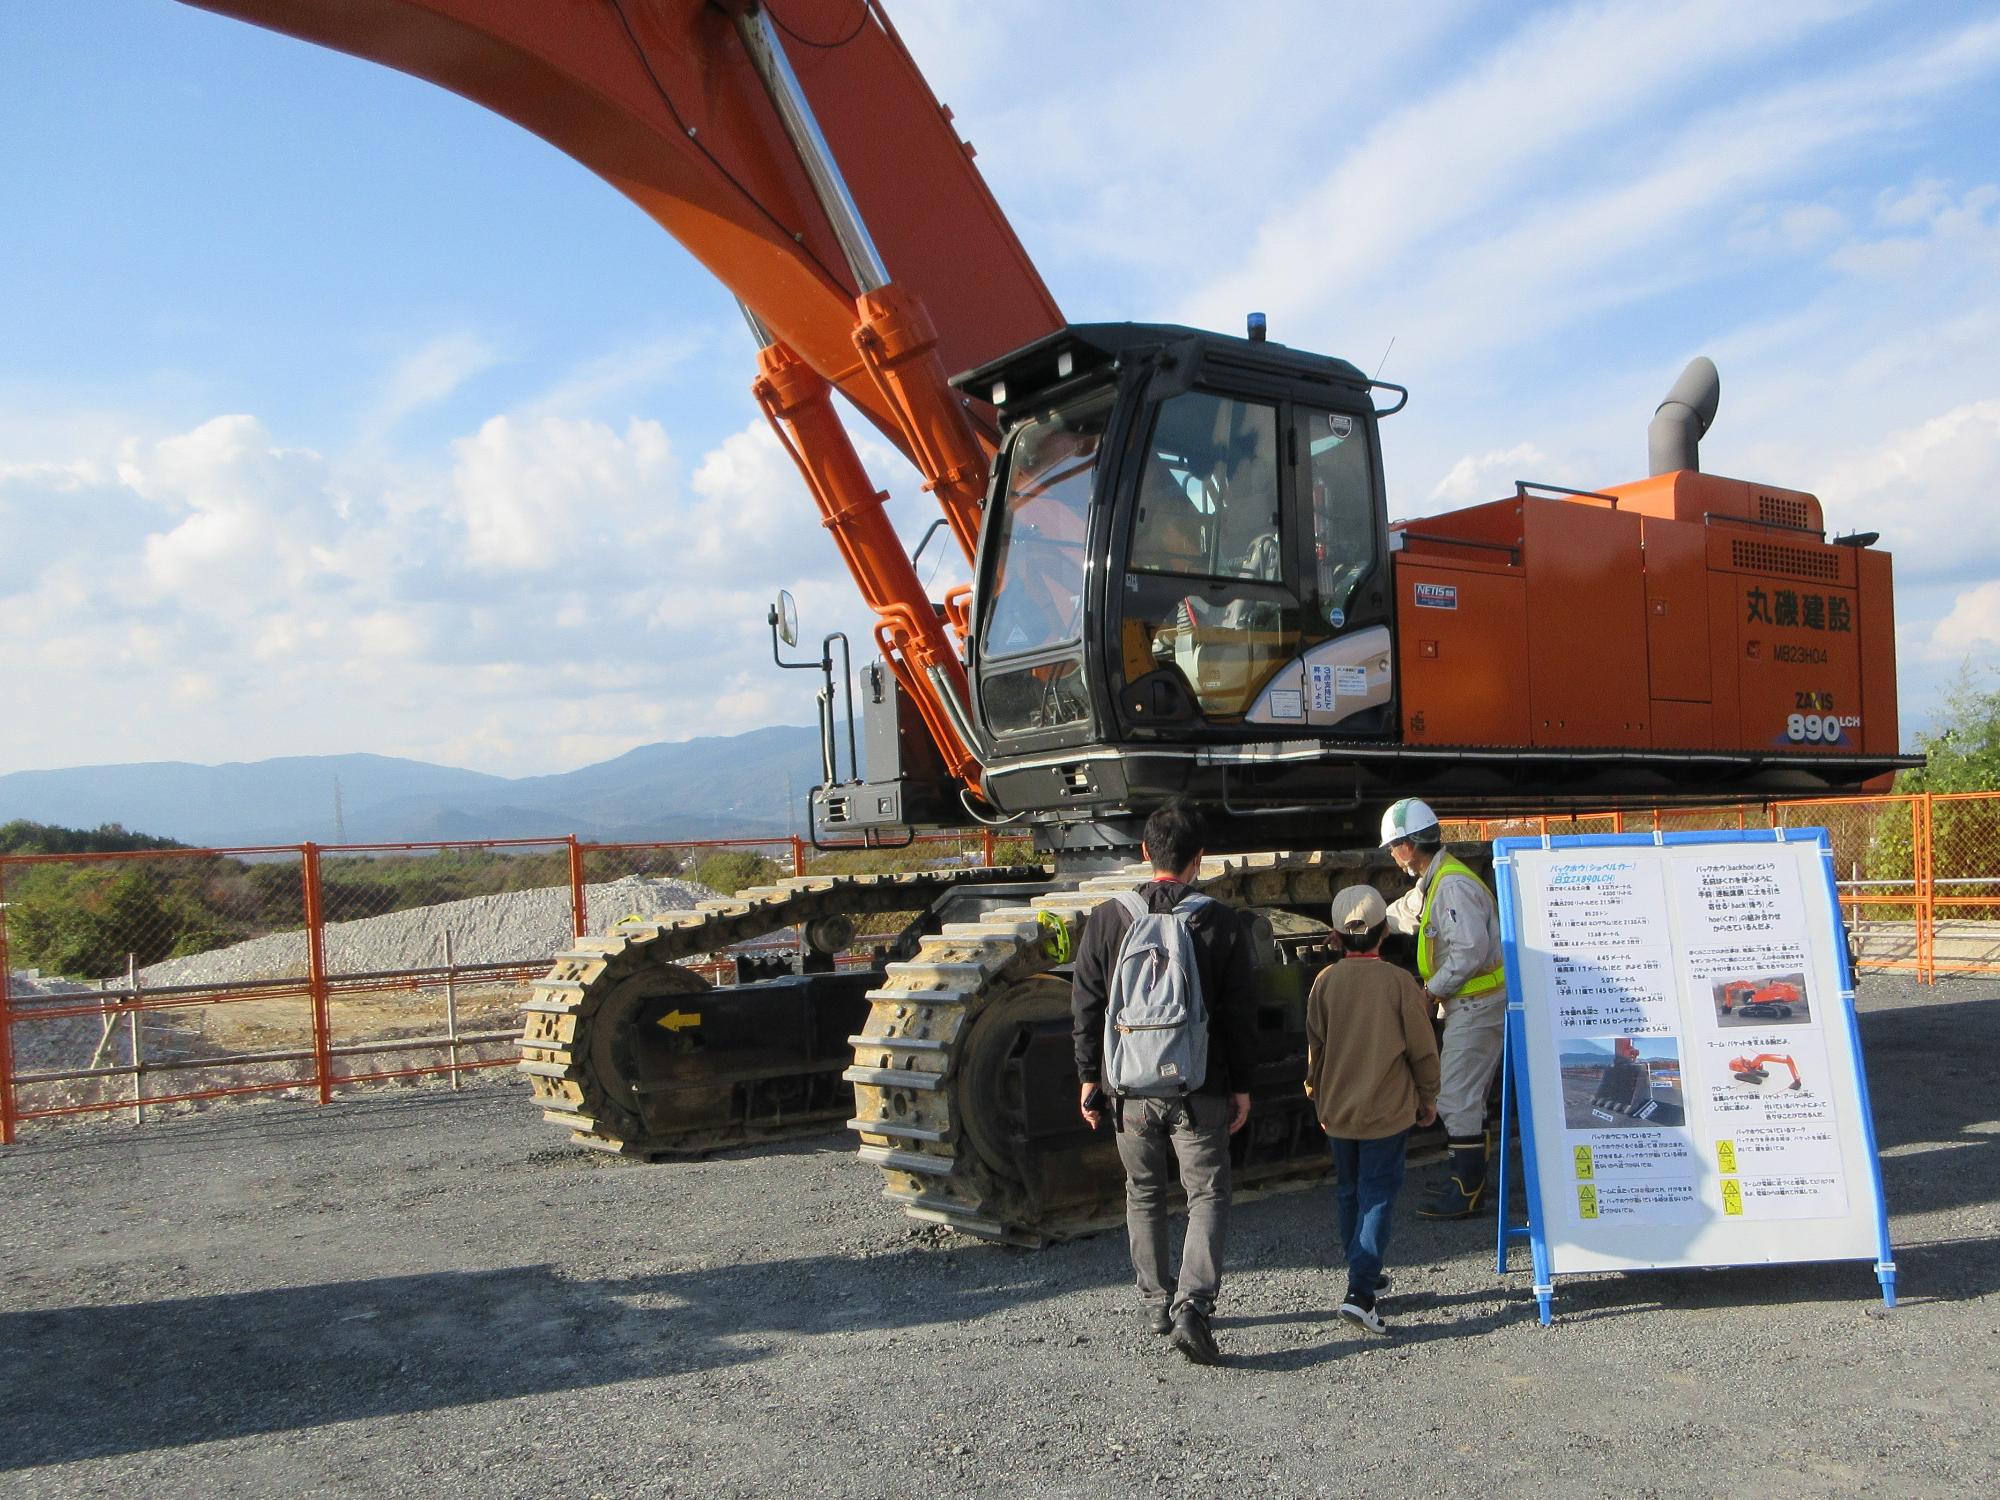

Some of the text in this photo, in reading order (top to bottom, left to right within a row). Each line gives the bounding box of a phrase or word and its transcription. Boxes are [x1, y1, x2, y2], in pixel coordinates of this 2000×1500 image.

[1417, 585, 1445, 596] NETIS
[1746, 586, 1851, 632] 丸磯建設
[1773, 643, 1827, 664] MB23H04
[1786, 713, 1860, 742] 890 LCH
